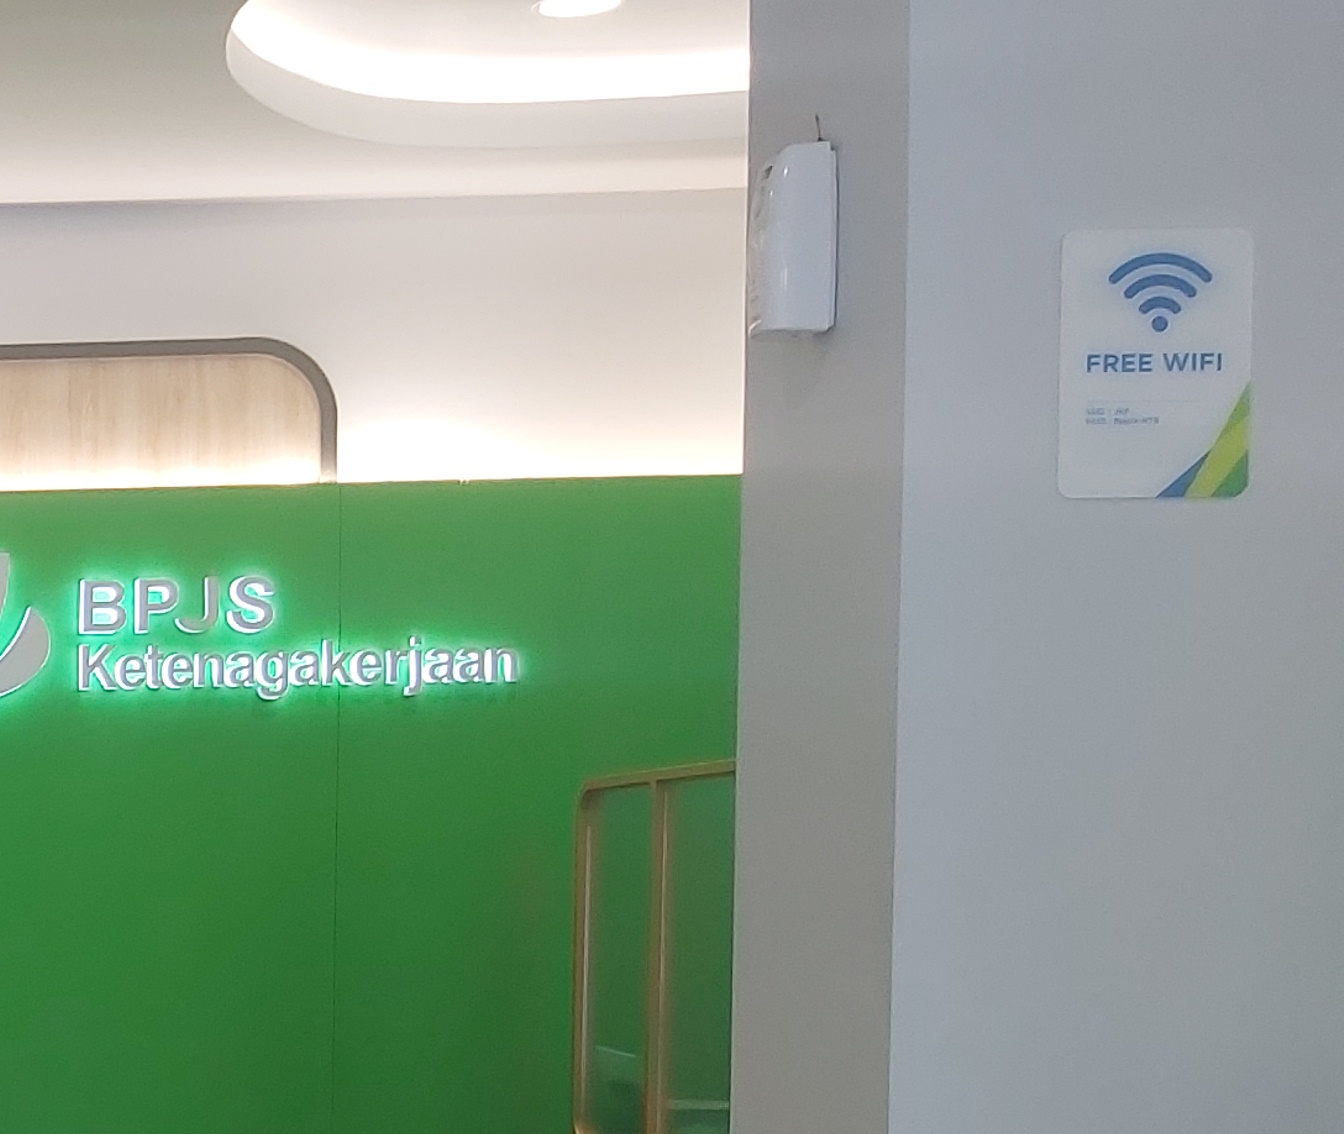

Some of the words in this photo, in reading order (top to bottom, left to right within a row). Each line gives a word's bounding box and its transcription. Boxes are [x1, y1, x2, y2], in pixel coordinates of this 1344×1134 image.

[1086, 354, 1153, 373] FREE
[1163, 353, 1223, 372] WIFI
[77, 575, 276, 635] BPJS
[77, 636, 518, 699] Ketenagakerjaan
